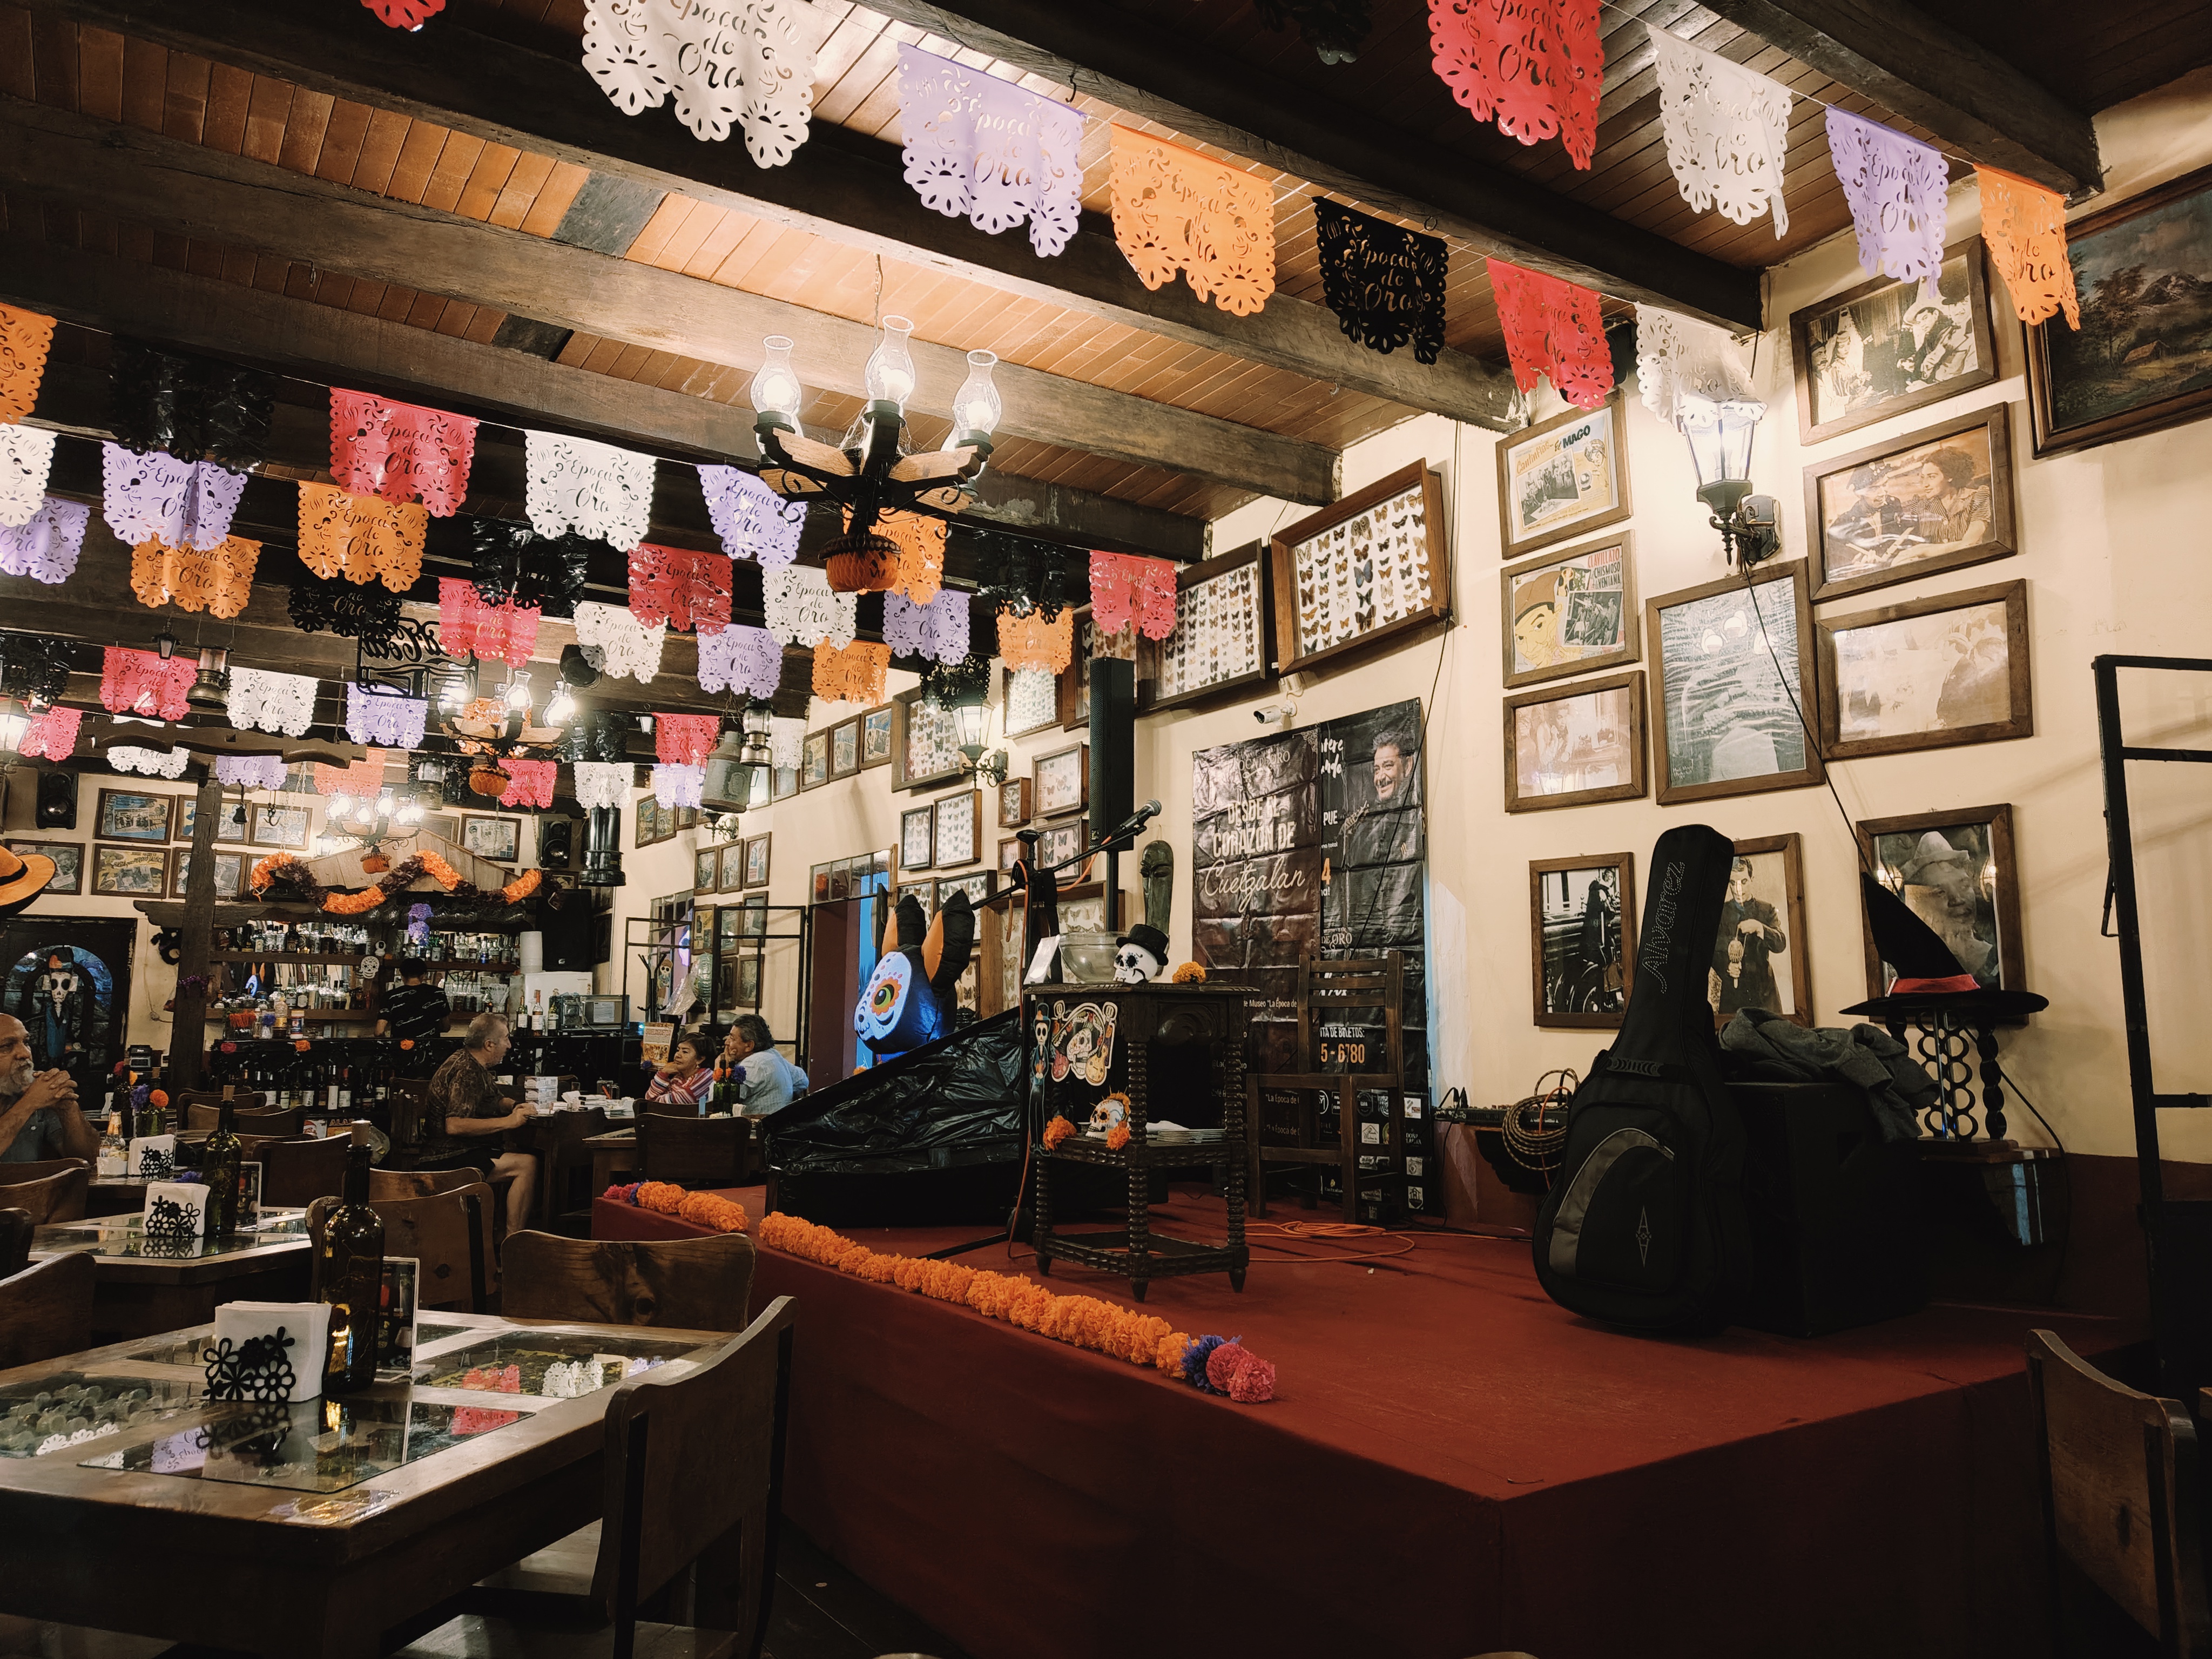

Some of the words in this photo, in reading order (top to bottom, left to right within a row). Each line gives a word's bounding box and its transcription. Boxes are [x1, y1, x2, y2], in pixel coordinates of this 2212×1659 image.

[663, 32, 745, 89] Oro
[968, 145, 1032, 187] Oro
[1360, 281, 1413, 312] Oro
[1562, 424, 1591, 449] MAGO
[375, 451, 427, 475] Oro
[565, 488, 610, 513] Oro
[339, 536, 383, 557] Oro
[1587, 548, 1620, 568] CLAVILLAZO
[171, 565, 214, 589] Oro
[1594, 561, 1621, 578] CHISMOSO
[793, 605, 830, 623] Oro
[603, 639, 636, 657] Oro
[372, 714, 400, 729] Oro
[1270, 750, 1291, 765] ORO
[1227, 798, 1264, 825] DESDE
[1266, 794, 1280, 818] EL
[1323, 810, 1338, 826] PUE
[1277, 821, 1296, 849] DE
[1321, 857, 1331, 886] 4
[1204, 856, 1306, 913] Cuetzalan
[1642, 861, 1686, 994] Alvarez
[1331, 932, 1353, 946] ORO
[1249, 999, 1266, 1008] Museo
[1275, 996, 1290, 1009] Época
[1330, 1027, 1338, 1038] DE
[1320, 1043, 1328, 1063] 5
[1338, 1043, 1365, 1064] 6780
